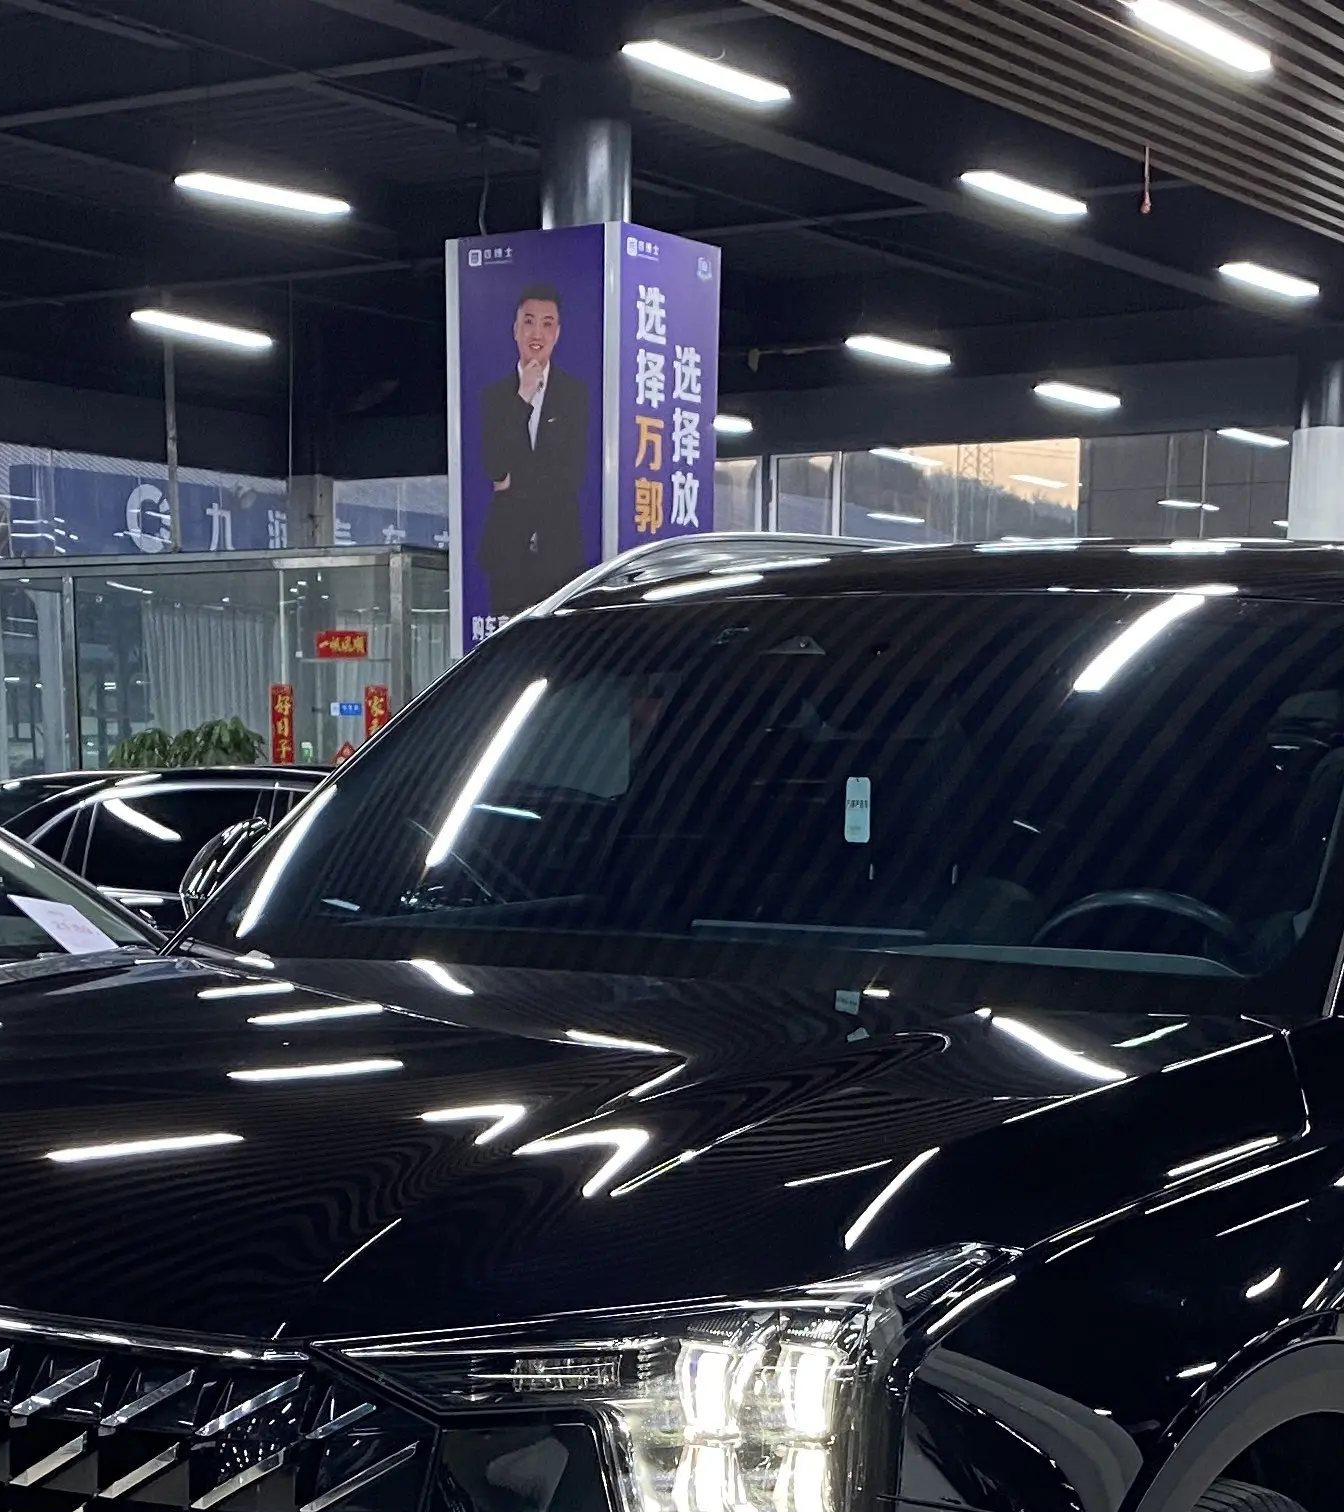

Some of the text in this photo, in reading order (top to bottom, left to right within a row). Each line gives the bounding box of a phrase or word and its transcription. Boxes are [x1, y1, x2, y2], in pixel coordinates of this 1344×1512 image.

[634, 284, 667, 535] 选择万郭
[670, 344, 703, 528] 选择放
